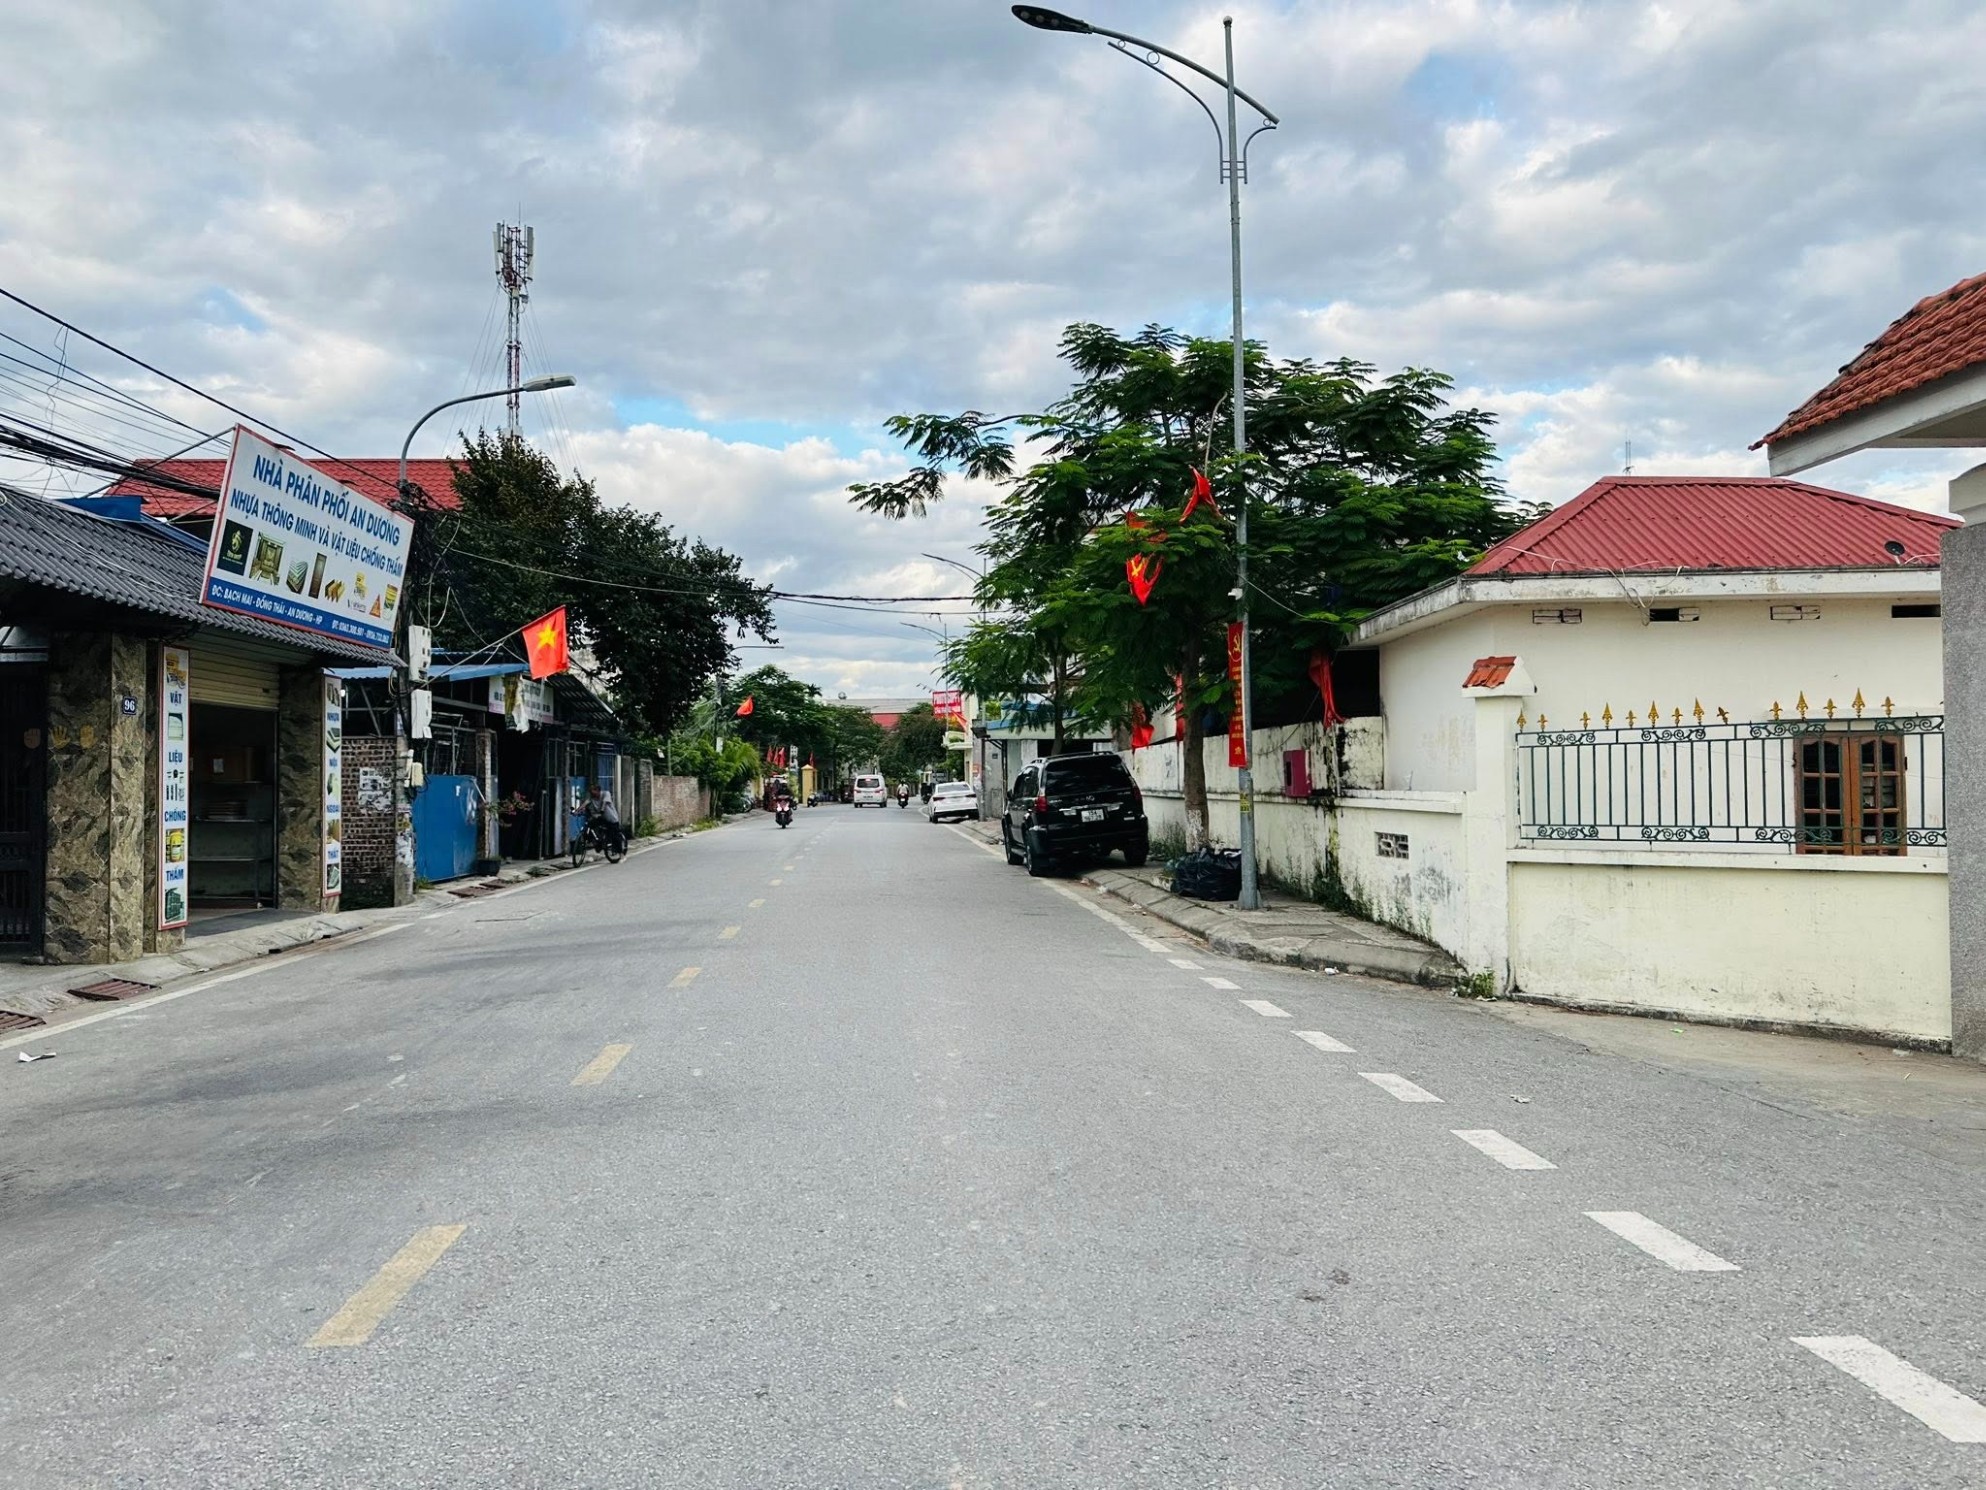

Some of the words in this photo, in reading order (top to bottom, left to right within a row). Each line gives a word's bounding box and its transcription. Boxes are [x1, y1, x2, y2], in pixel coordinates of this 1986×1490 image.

[253, 454, 283, 491] NHÀ
[285, 474, 321, 508] PHÂN
[321, 491, 350, 522] PHỐI
[349, 505, 367, 530] AN
[366, 513, 400, 546] DƯƠNG
[230, 488, 260, 519] NHỰA
[261, 502, 294, 531] THÔNG
[294, 516, 318, 541] MINH
[318, 525, 330, 547] VÀ
[331, 531, 346, 556] VẬT
[345, 537, 361, 562] LIỆU
[361, 546, 386, 570] CHỐNG
[241, 593, 253, 606] MAI
[286, 606, 297, 617] AN
[124, 699, 135, 711] 96
[170, 691, 182, 706] VẬT
[168, 749, 183, 765] LIỆU
[165, 806, 186, 822] CHỐNG
[166, 865, 184, 881] THẤM
